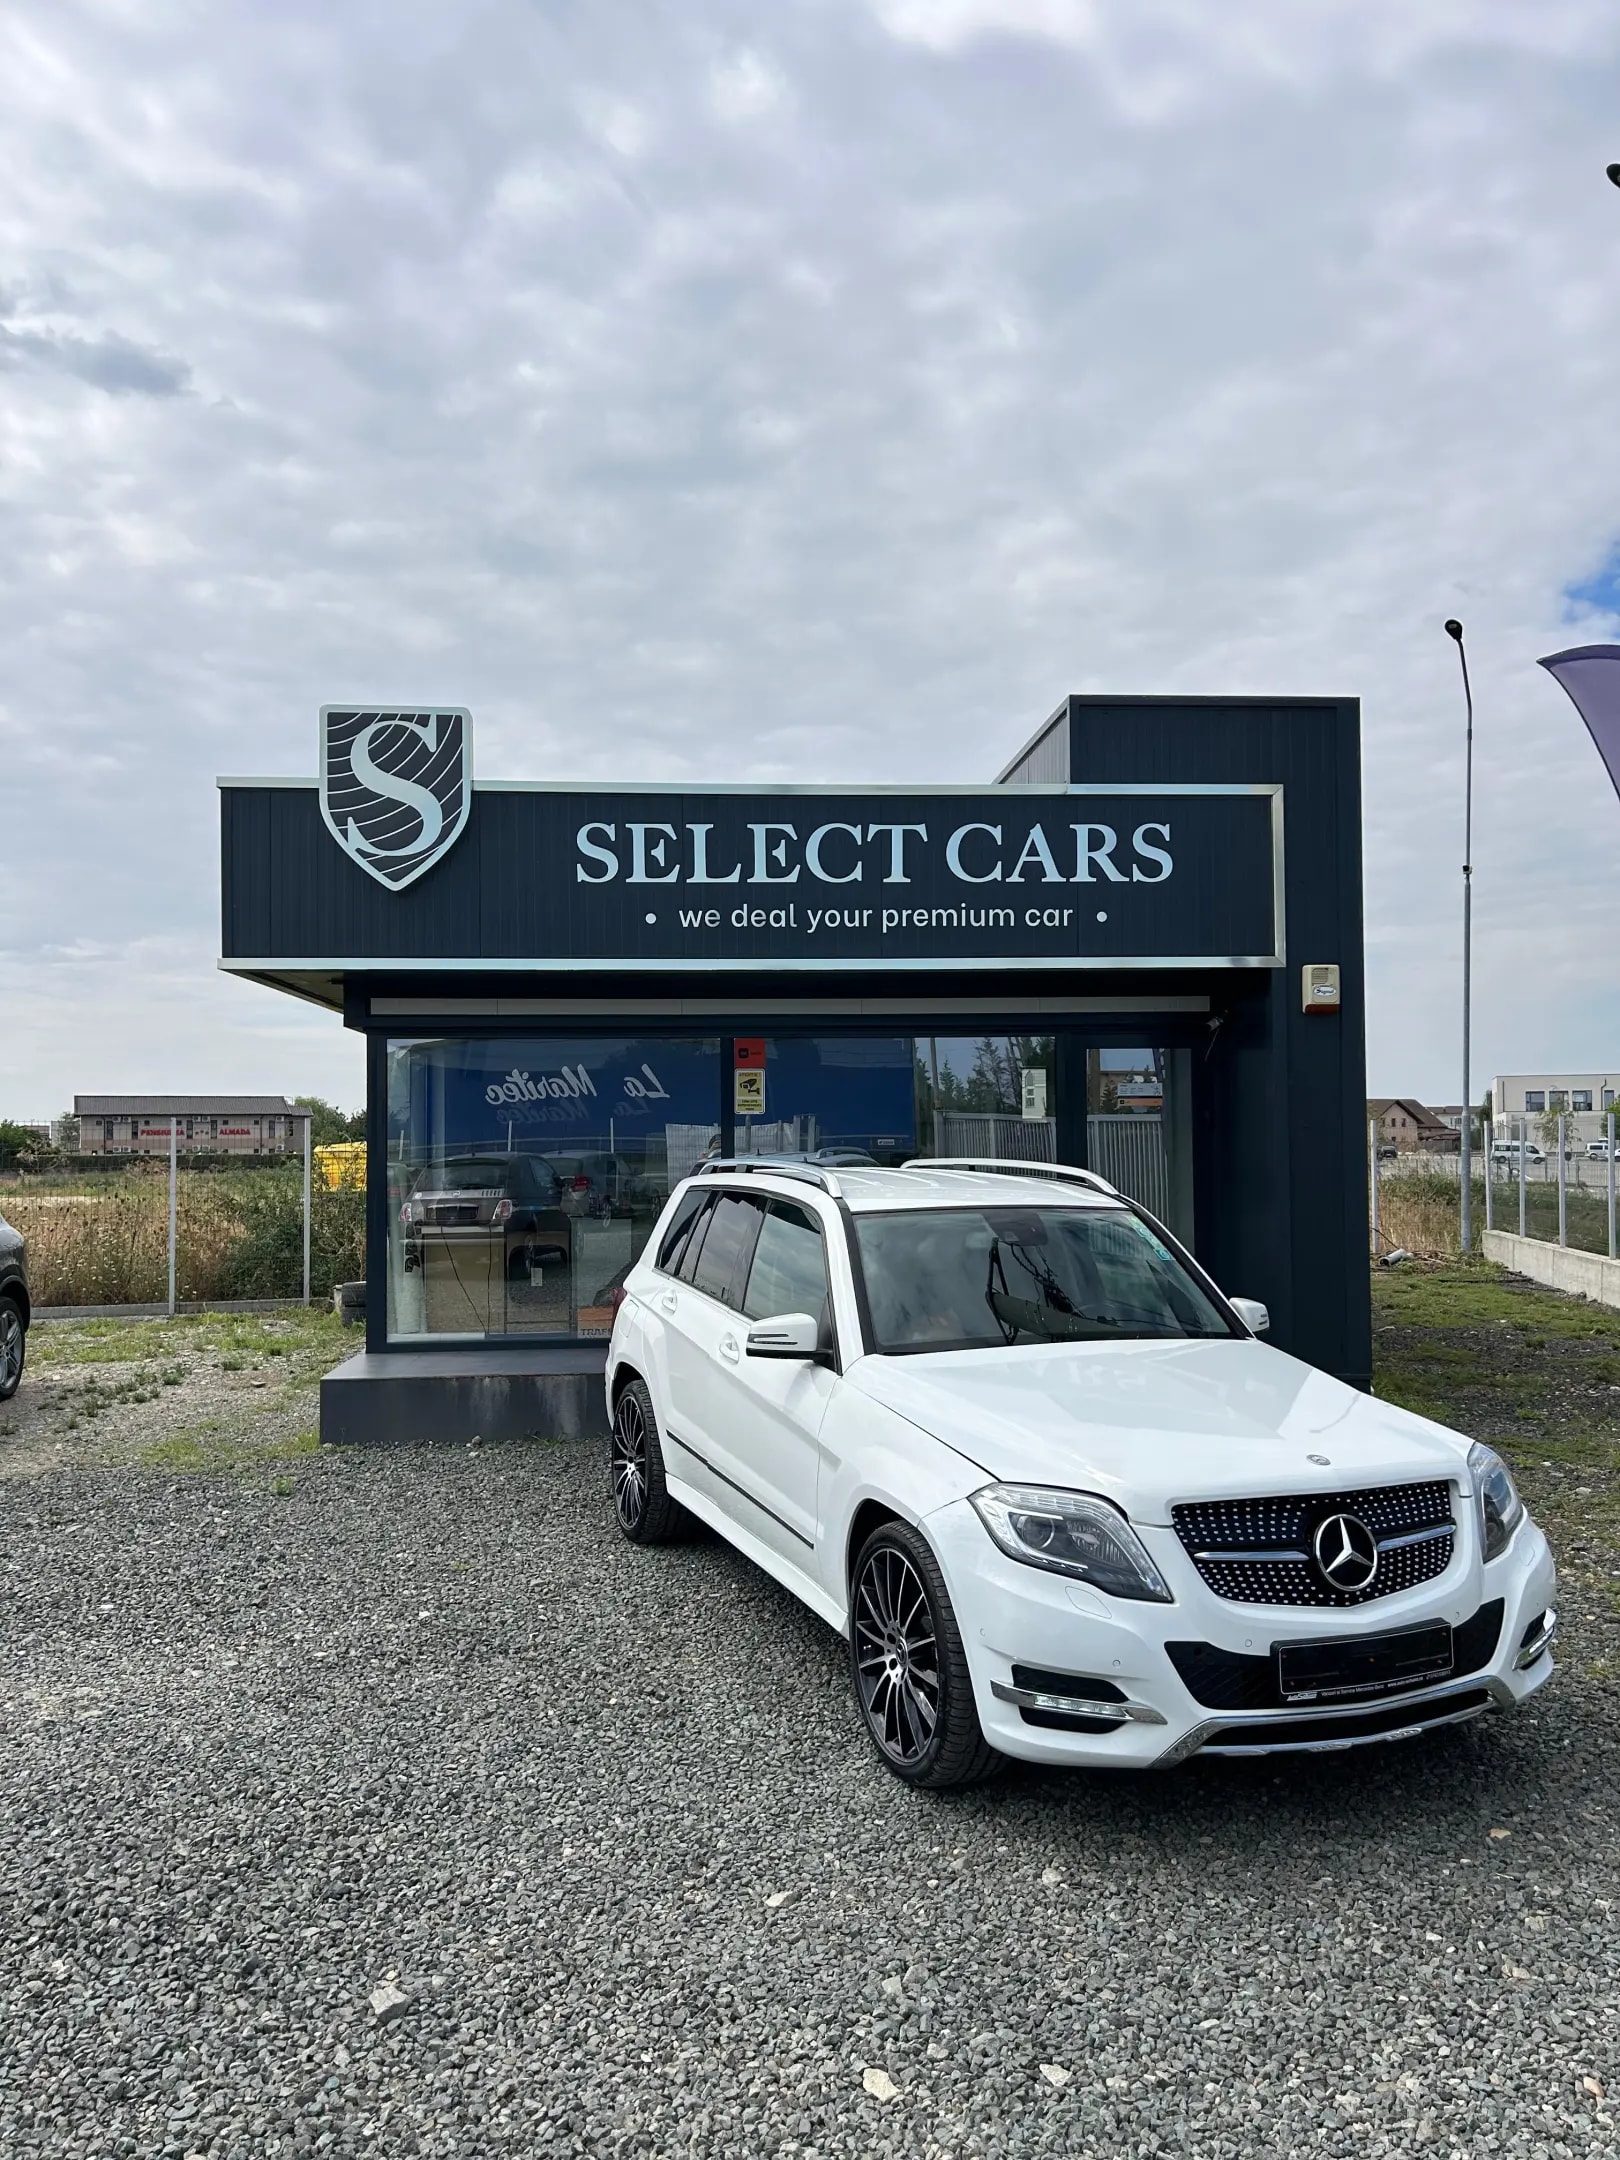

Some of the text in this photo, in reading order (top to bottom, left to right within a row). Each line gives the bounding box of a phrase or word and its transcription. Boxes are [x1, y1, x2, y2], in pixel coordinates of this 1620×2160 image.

[347, 713, 443, 857] S
[576, 822, 1174, 883] SELECT CARS
[678, 902, 1074, 933] we deal your premium car
[219, 1128, 251, 1136] ALMADA
